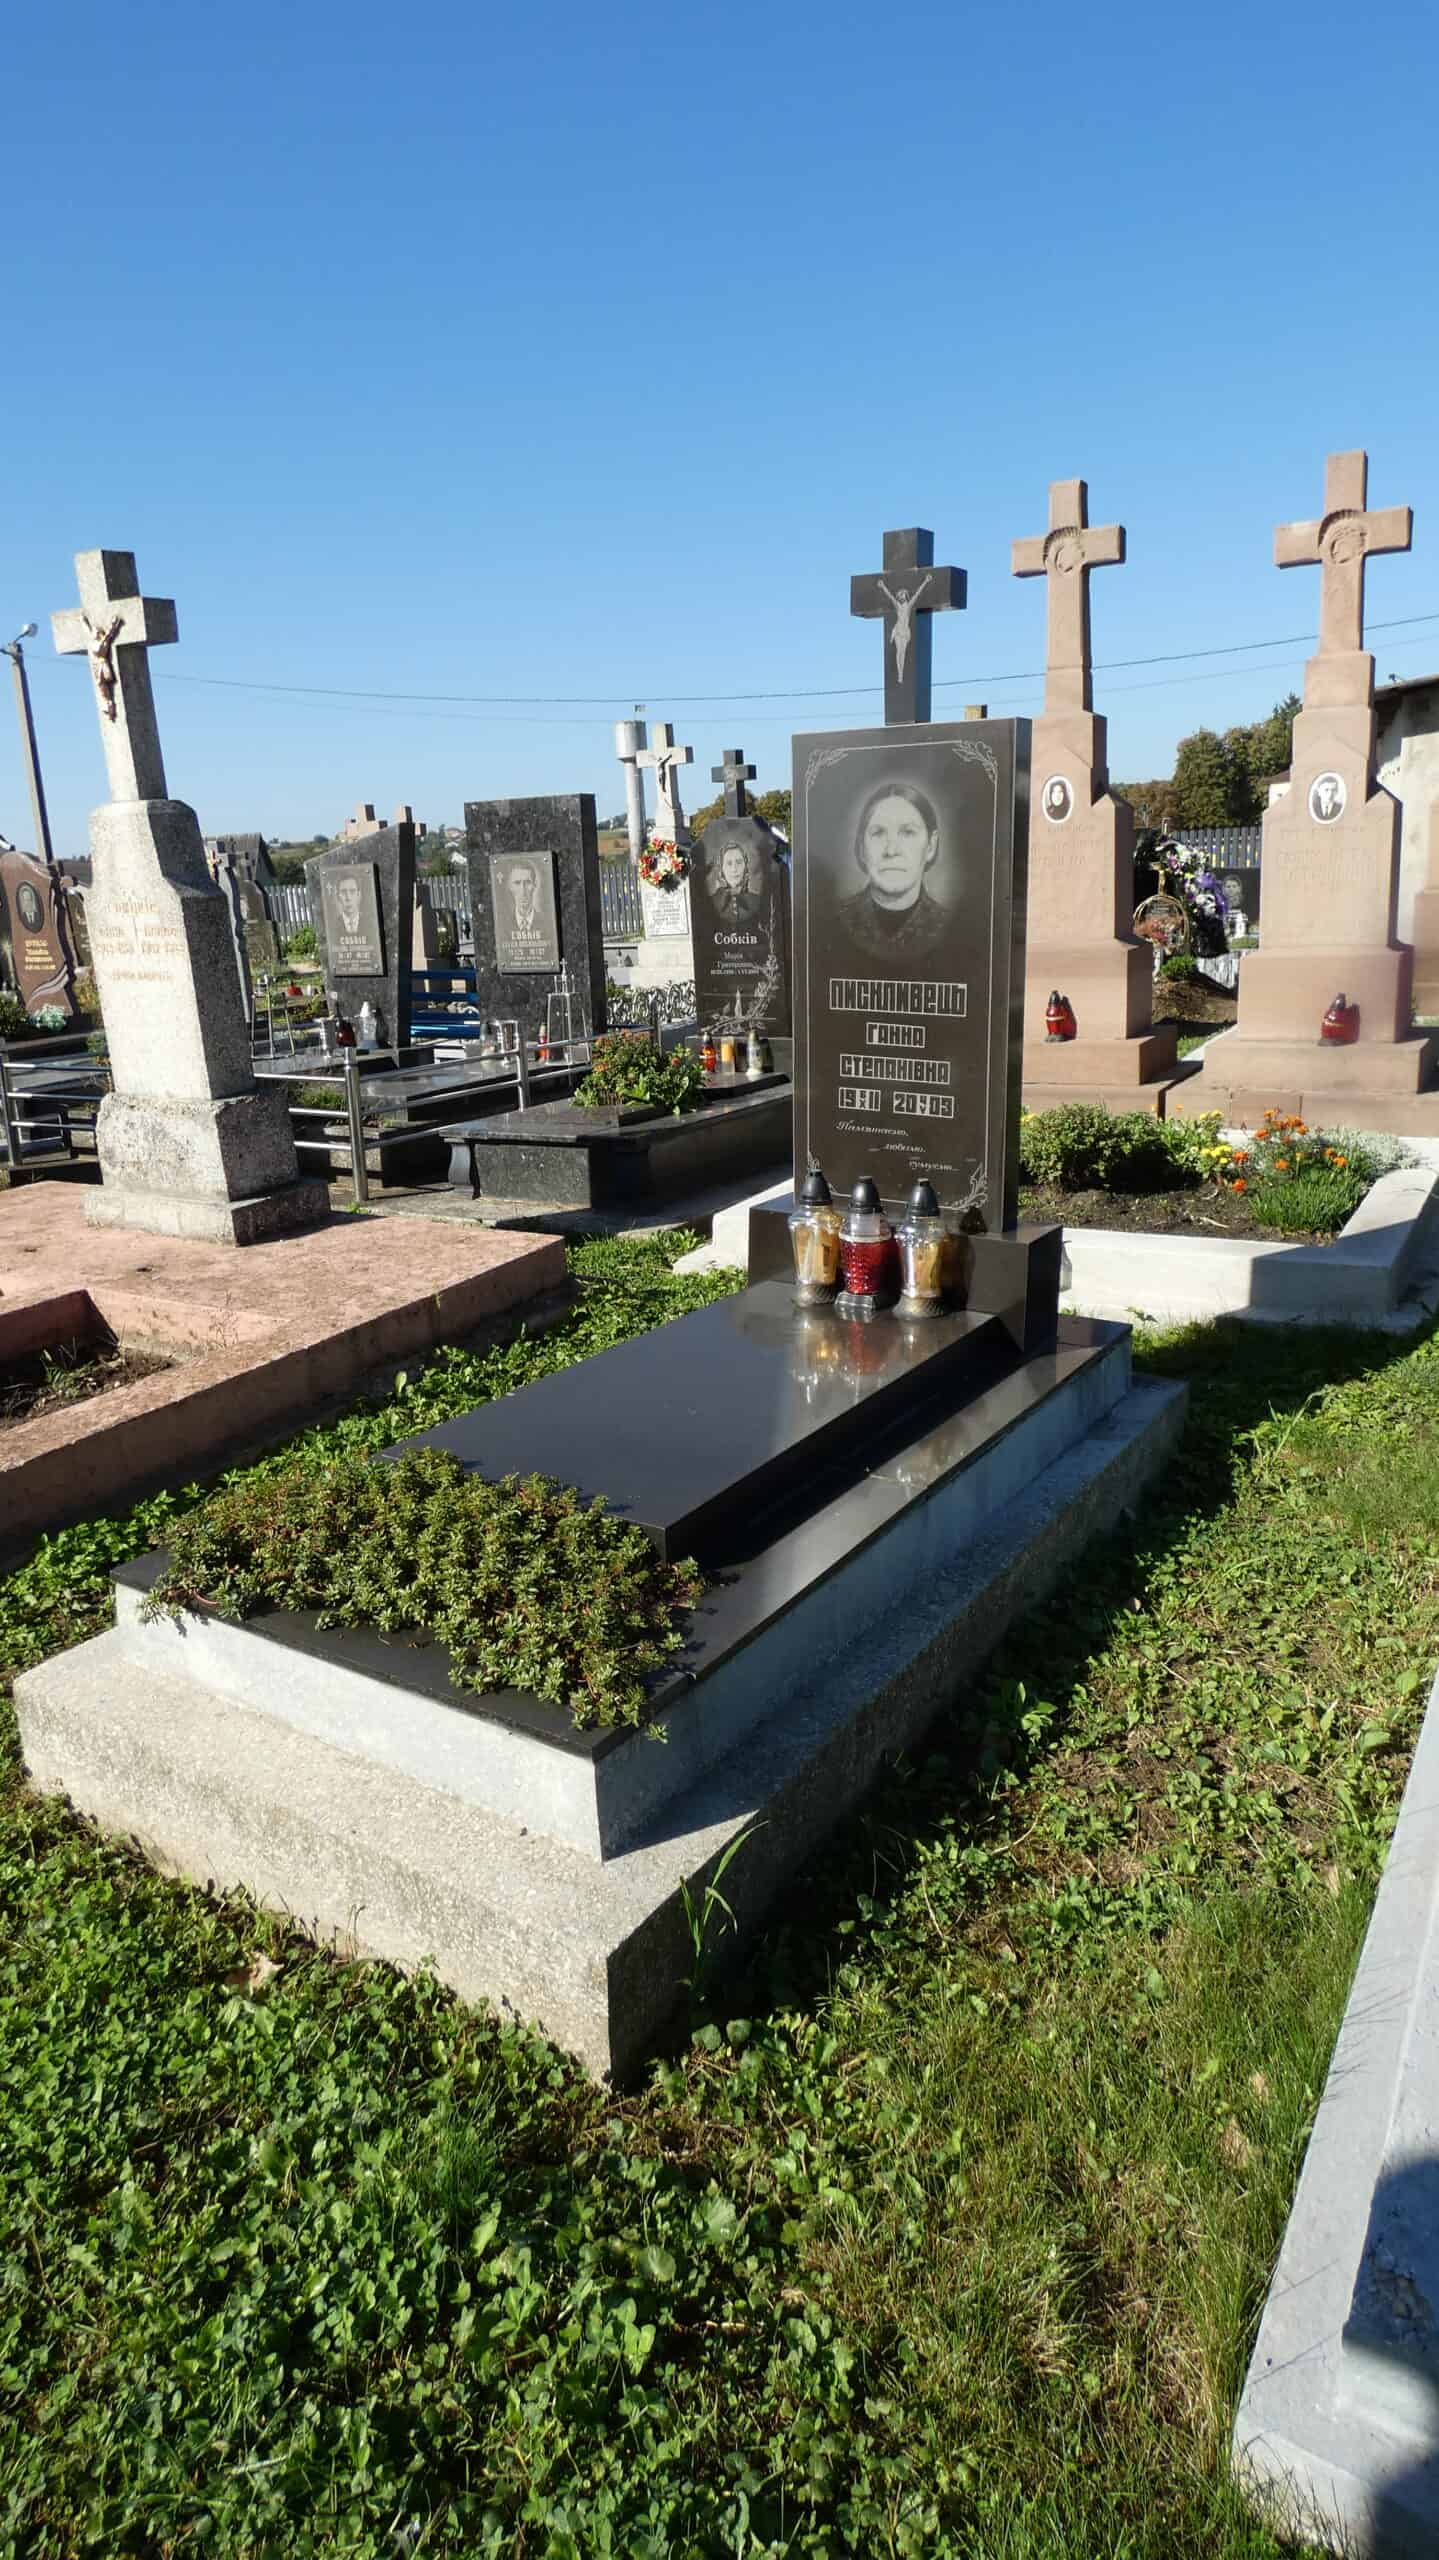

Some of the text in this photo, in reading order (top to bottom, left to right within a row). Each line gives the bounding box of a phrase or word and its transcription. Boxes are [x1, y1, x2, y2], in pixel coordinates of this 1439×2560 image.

[714, 932, 758, 945] Собків
[829, 978, 967, 1018] ПИСКЛИВЕЦЬ
[865, 1022, 926, 1048] ГАННА
[840, 1053, 951, 1085] СТЕПАНІВНА
